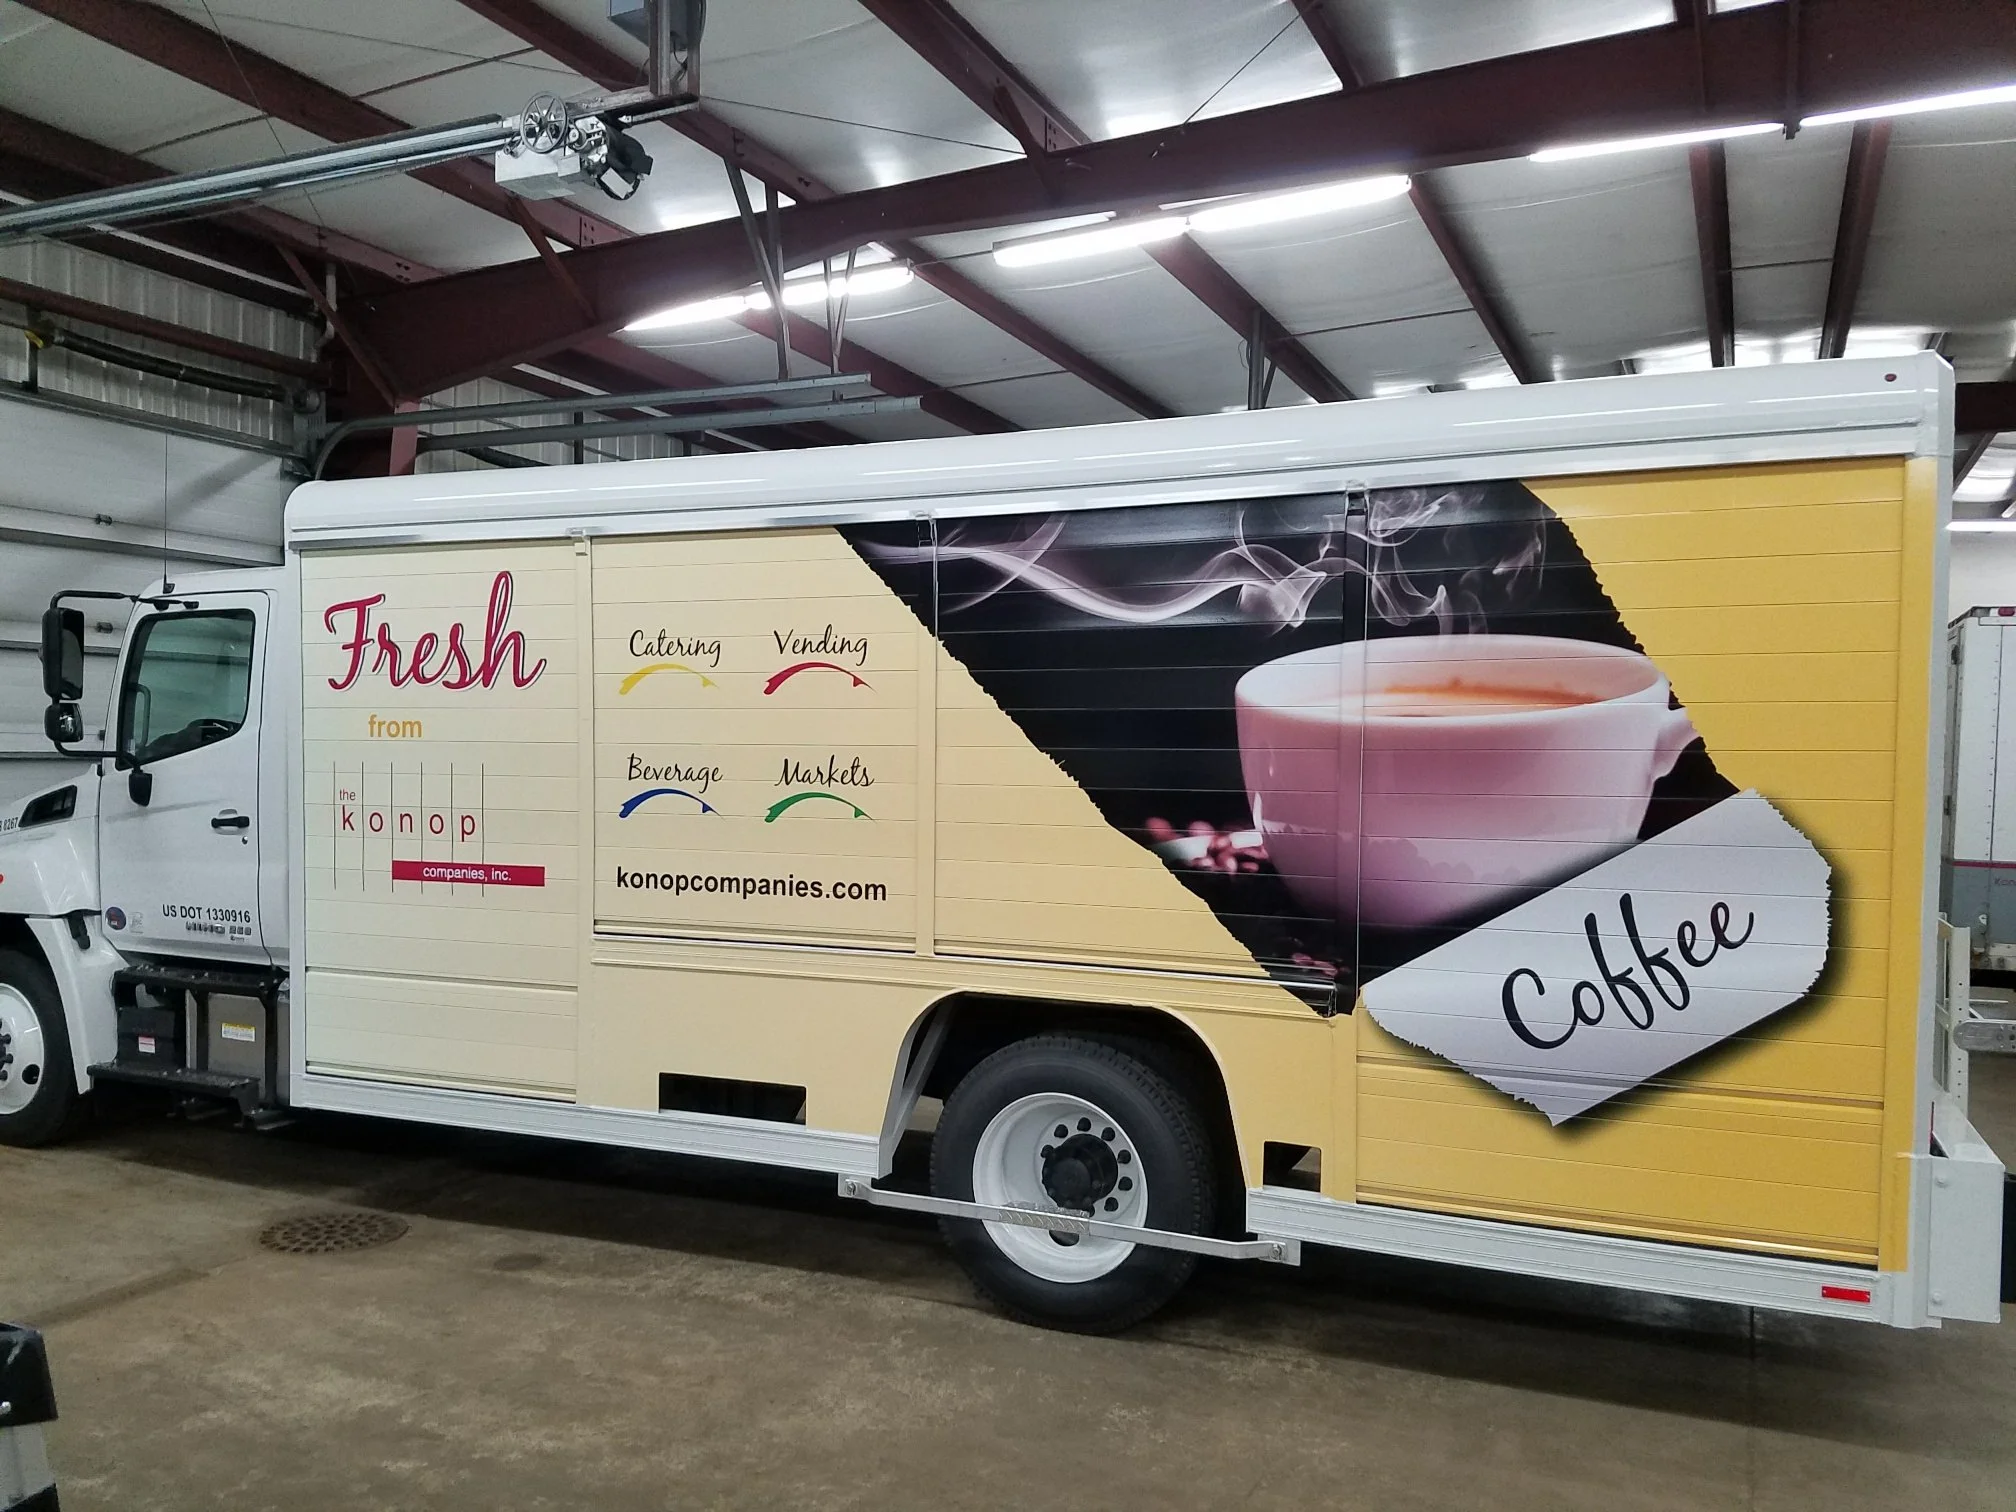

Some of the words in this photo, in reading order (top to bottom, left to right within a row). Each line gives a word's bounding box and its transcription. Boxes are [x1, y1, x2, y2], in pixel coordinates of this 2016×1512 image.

[323, 571, 547, 690] Fresh
[629, 628, 721, 668] Catering
[773, 624, 868, 666] Vending
[368, 714, 423, 738] from
[627, 753, 724, 793] Beverage
[774, 754, 875, 788] Markets
[339, 789, 356, 801] the
[342, 804, 476, 842] konop
[423, 866, 488, 882] companies,
[491, 868, 512, 881] inc.
[616, 866, 887, 901] konopcompanies.com
[162, 904, 177, 918] US
[180, 905, 202, 920] DOT
[205, 907, 251, 923] 1330916
[1502, 893, 1754, 1049] Coffee
